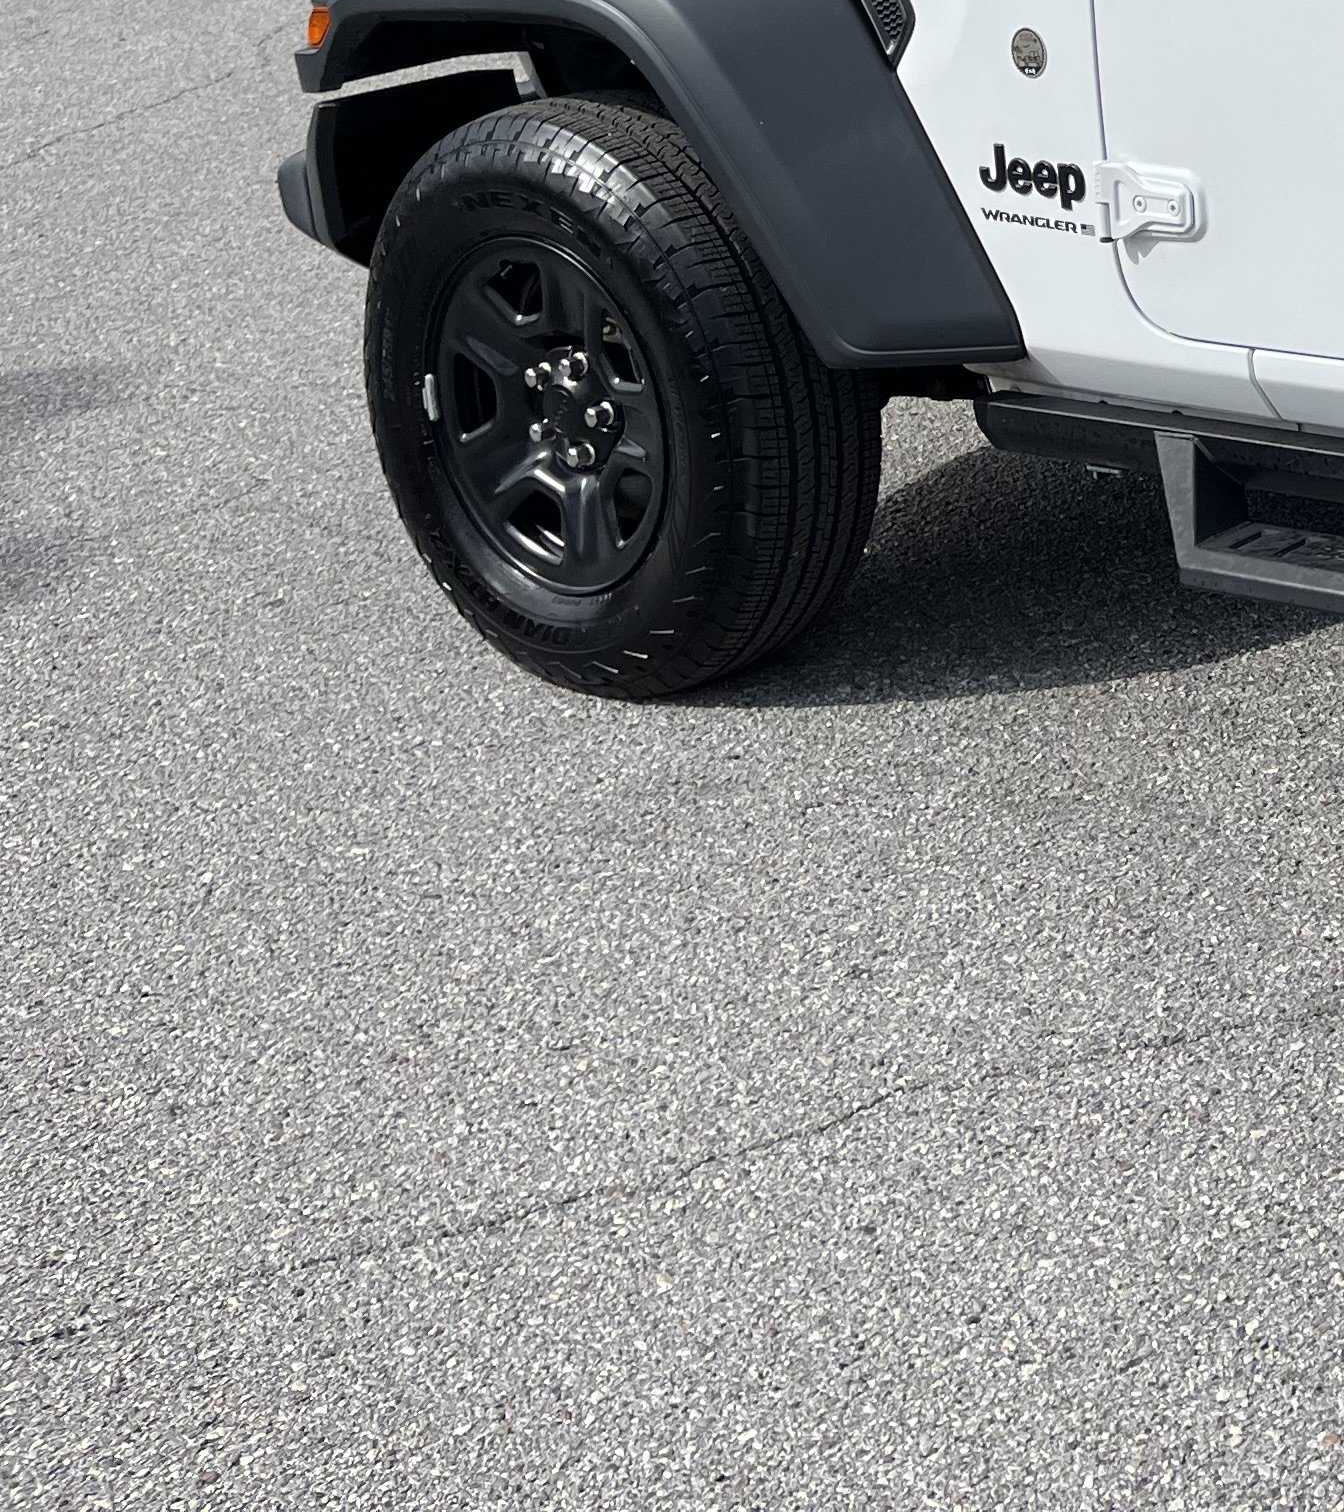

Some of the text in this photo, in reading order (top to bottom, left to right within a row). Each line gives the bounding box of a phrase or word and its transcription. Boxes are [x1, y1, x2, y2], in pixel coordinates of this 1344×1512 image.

[979, 143, 1087, 210] Jeep
[460, 190, 602, 255] NEXEN
[980, 207, 1079, 234] WRANGLER
